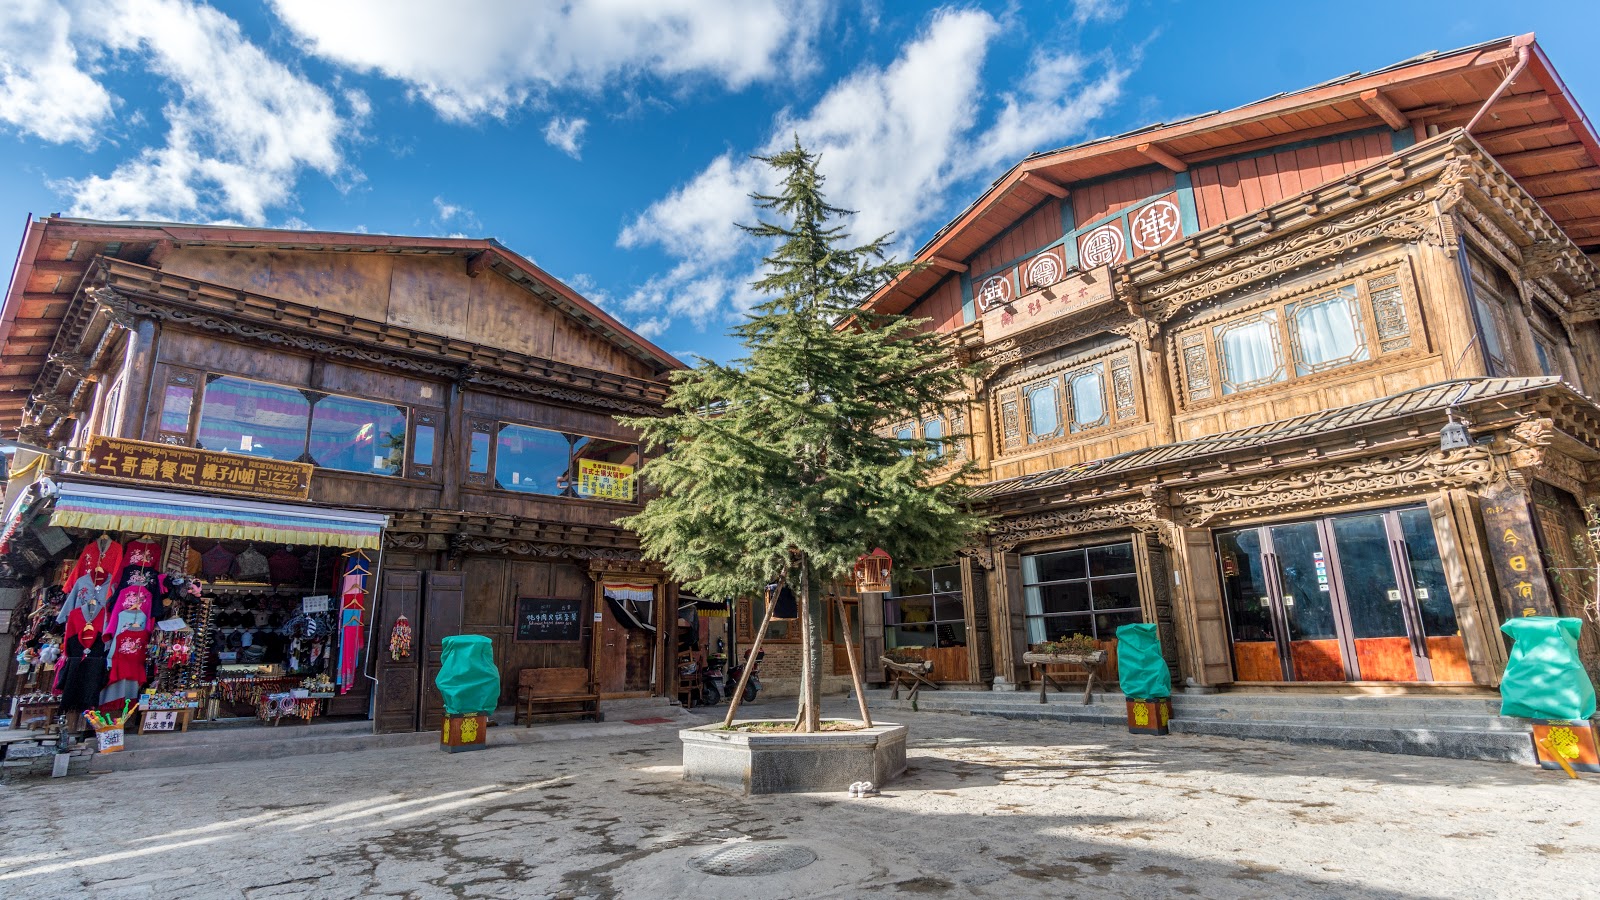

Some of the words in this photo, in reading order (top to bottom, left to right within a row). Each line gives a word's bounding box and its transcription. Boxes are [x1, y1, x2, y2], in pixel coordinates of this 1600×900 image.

[204, 455, 244, 466] THUPTEN
[249, 461, 300, 473] RESTAURANT
[259, 470, 298, 483] PIZZA
